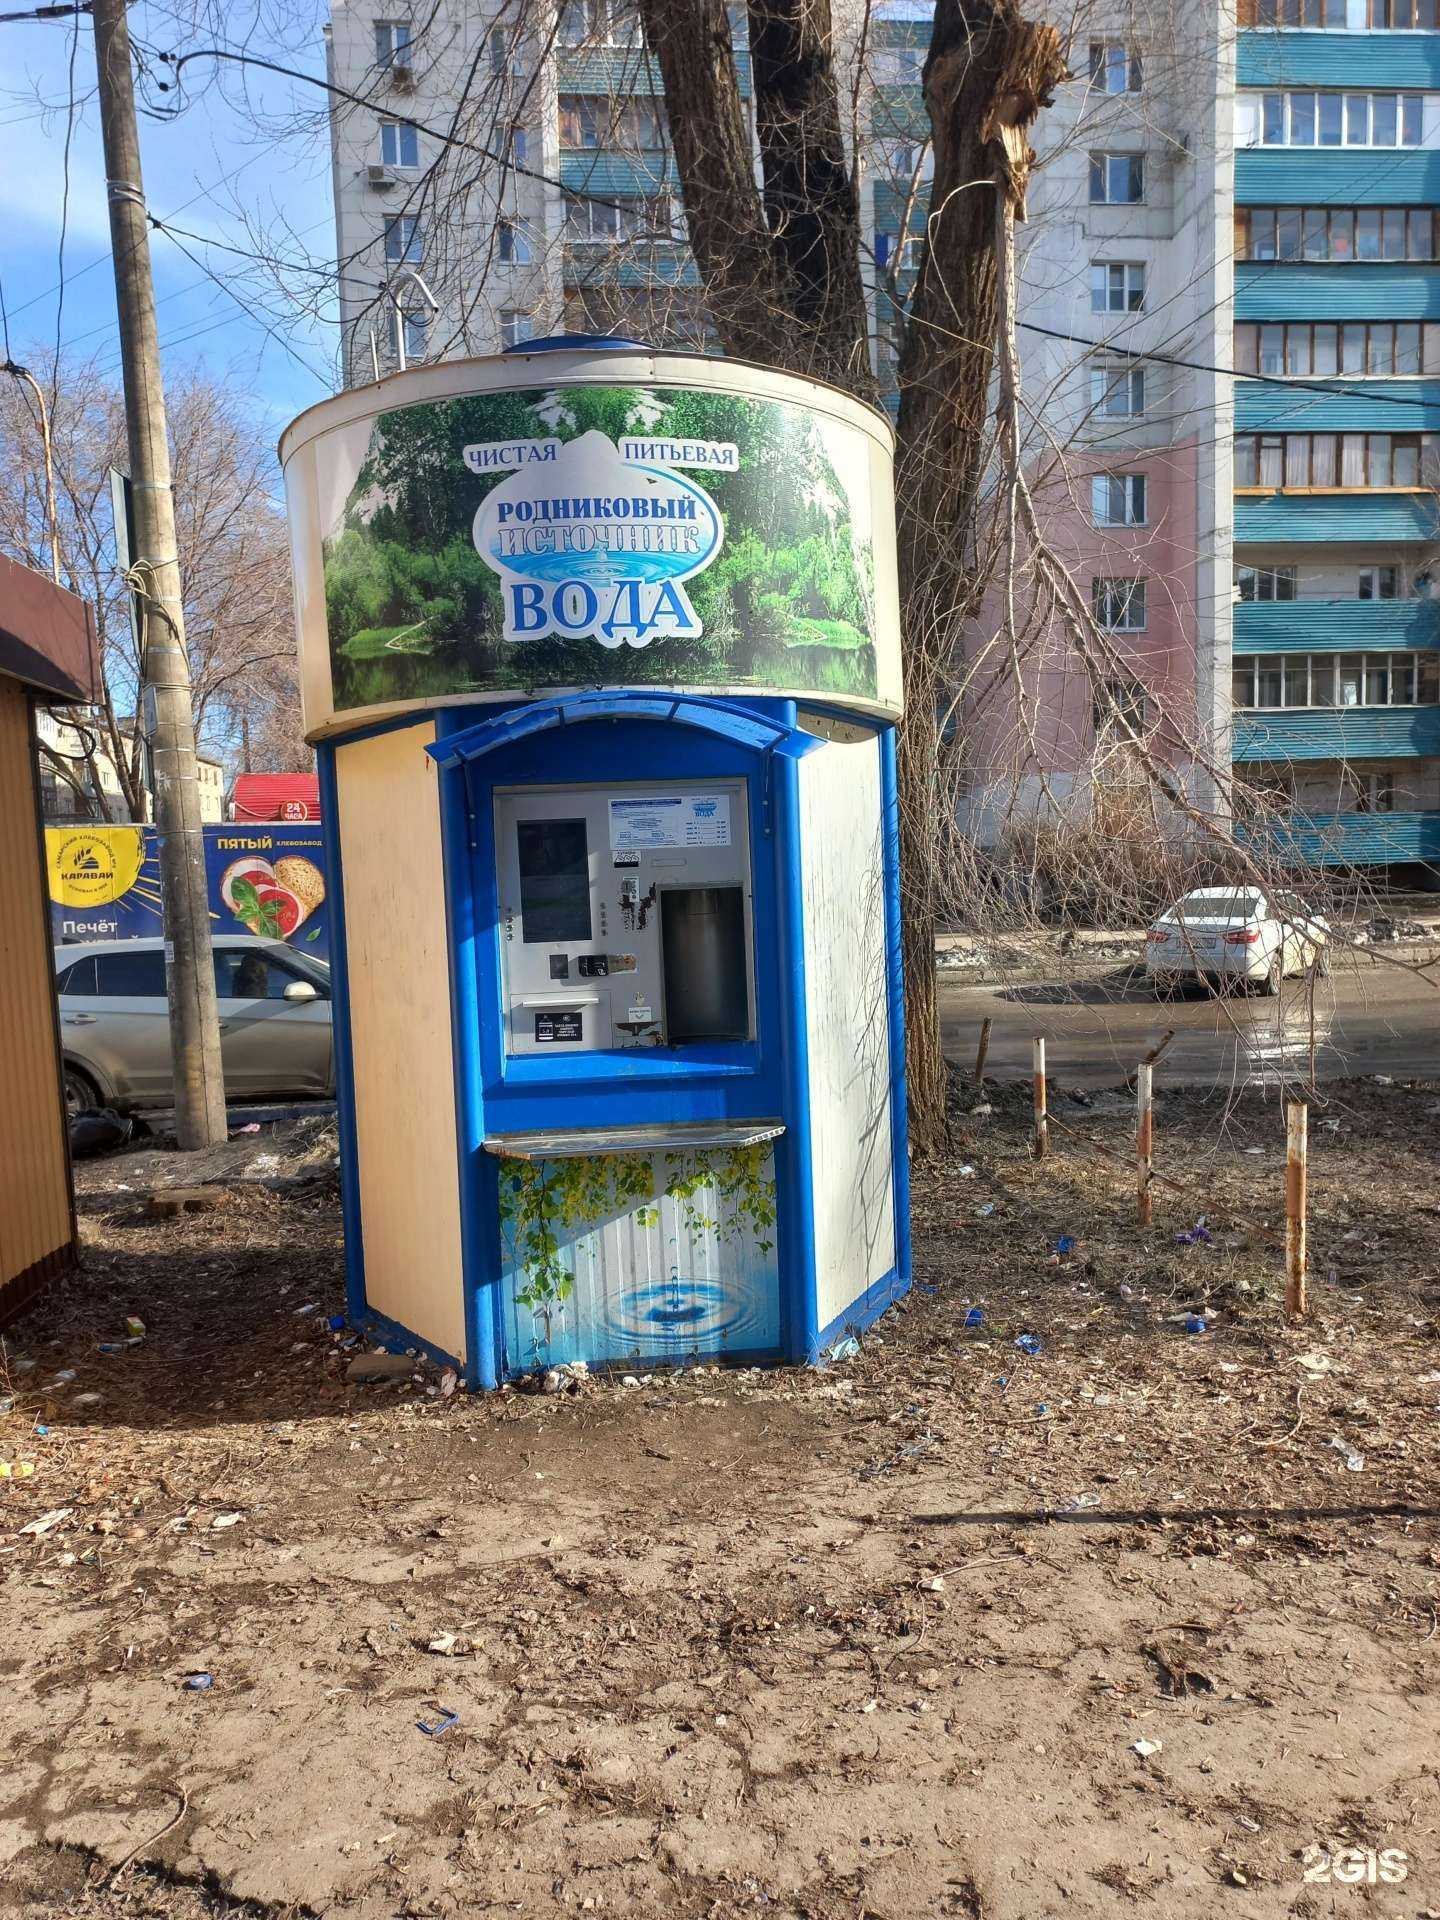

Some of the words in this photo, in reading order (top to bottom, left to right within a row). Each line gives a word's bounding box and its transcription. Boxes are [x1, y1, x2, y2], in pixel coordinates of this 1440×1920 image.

[468, 444, 557, 467] ЧИСТАЯ
[625, 443, 734, 465] ПИТЬЕВАЯ
[497, 494, 697, 524] РОДНИКОВЫЙ
[498, 524, 700, 557] ИСТОЧНИК
[510, 580, 694, 639] ВОДА
[284, 812, 304, 820] ЧАСА
[286, 802, 301, 813] 24
[217, 835, 273, 850] ПЯТЫЙ
[276, 839, 323, 847] ХЛЕБОЗАВОД
[62, 919, 118, 934] Печёт
